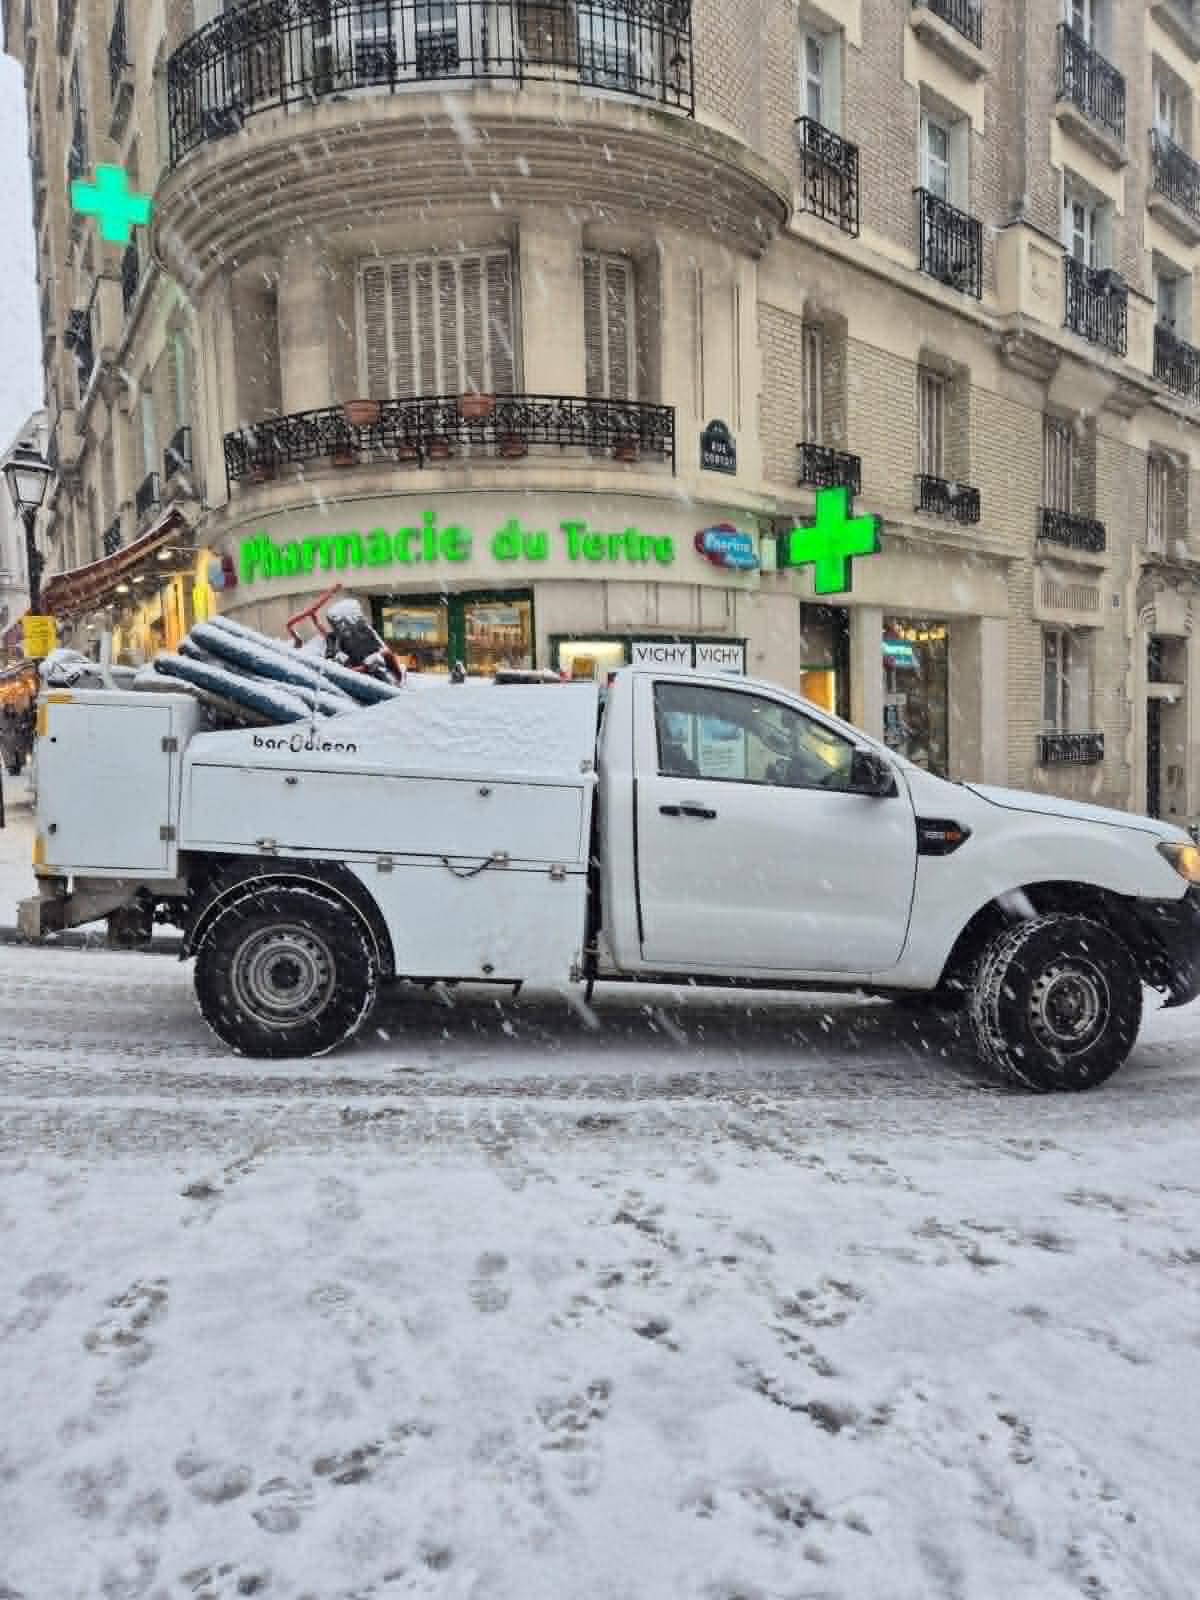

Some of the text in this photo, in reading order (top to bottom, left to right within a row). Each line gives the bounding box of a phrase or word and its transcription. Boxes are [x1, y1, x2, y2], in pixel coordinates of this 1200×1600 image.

[711, 440, 727, 453] RUE
[240, 512, 674, 584] Pharmacie du Tertre
[637, 647, 687, 662] VICHY
[700, 648, 740, 664] VICHY
